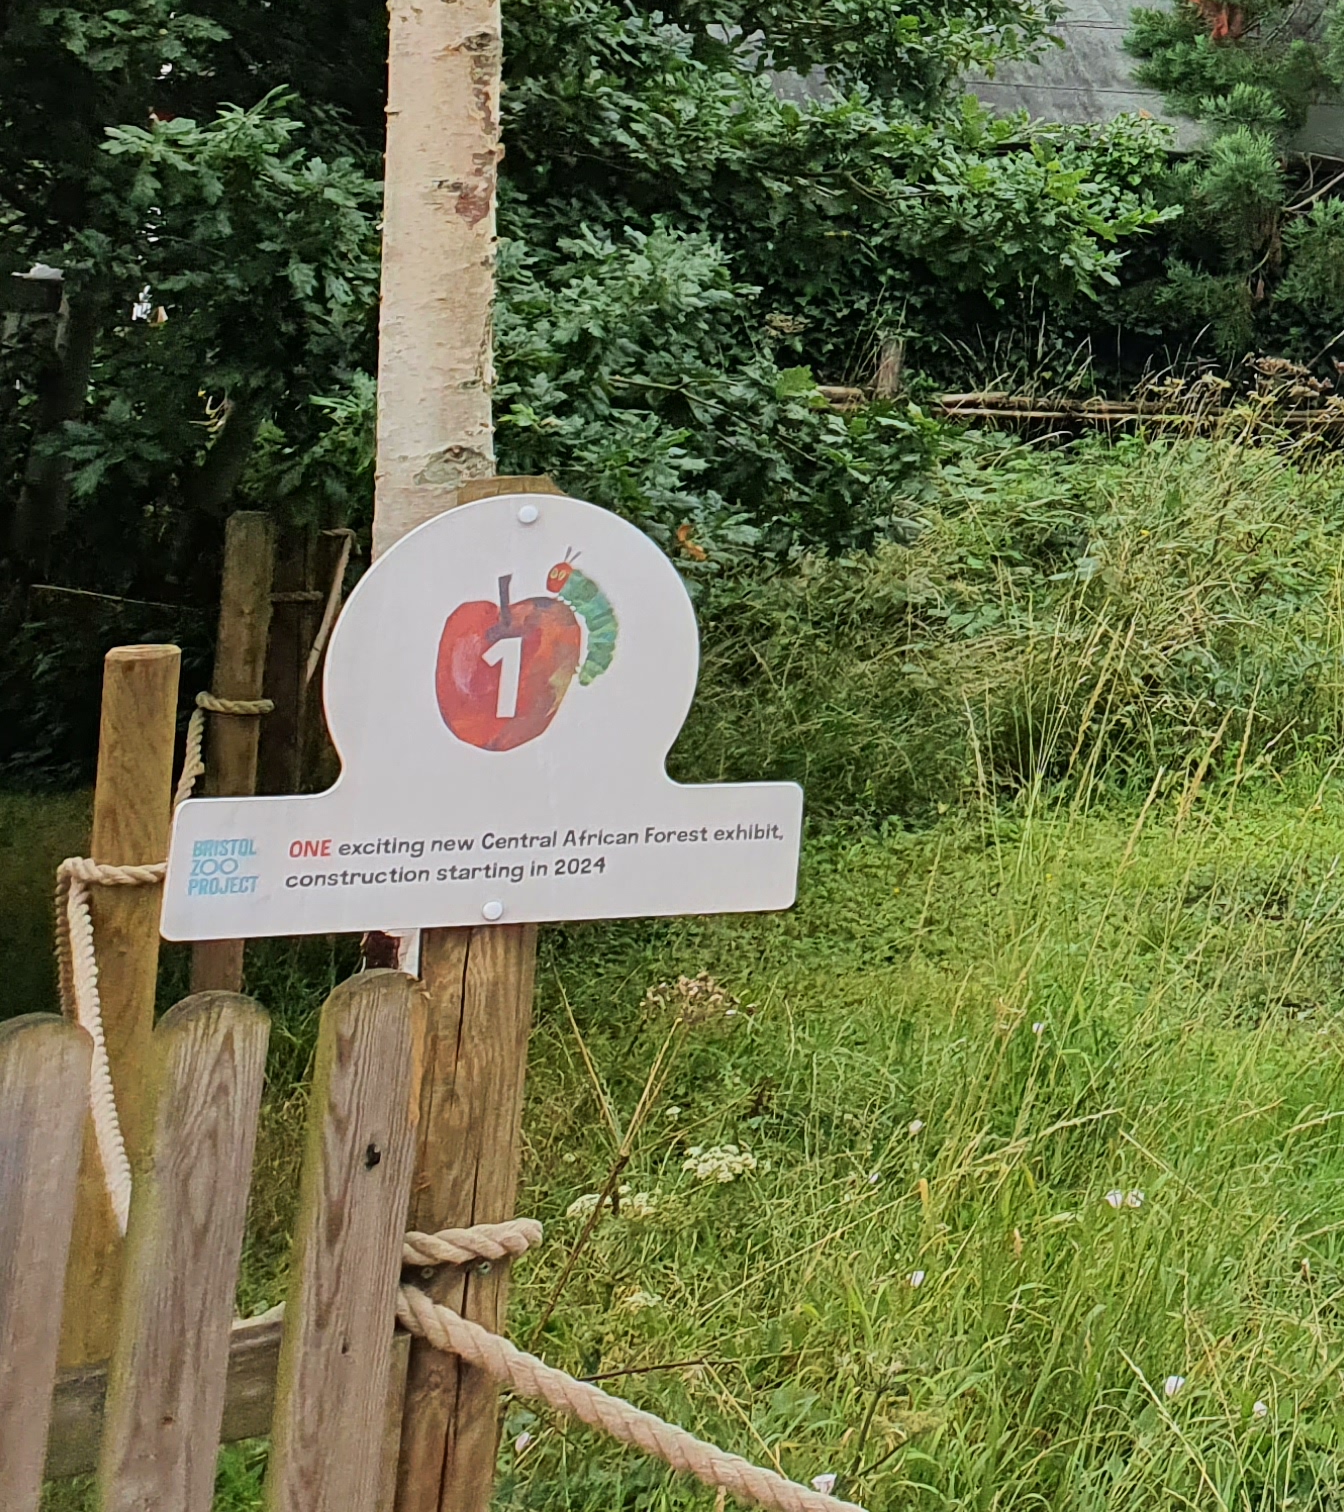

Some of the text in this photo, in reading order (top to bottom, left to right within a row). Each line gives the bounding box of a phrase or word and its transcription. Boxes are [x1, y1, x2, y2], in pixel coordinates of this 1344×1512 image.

[482, 637, 522, 718] 1
[192, 839, 257, 857] BRISTOL
[289, 823, 784, 858] ONE exciting new Central African Forest exhibit,
[191, 858, 238, 875] ZOO
[285, 857, 606, 888] construction starting in 2024
[188, 876, 259, 896] PROJECT
